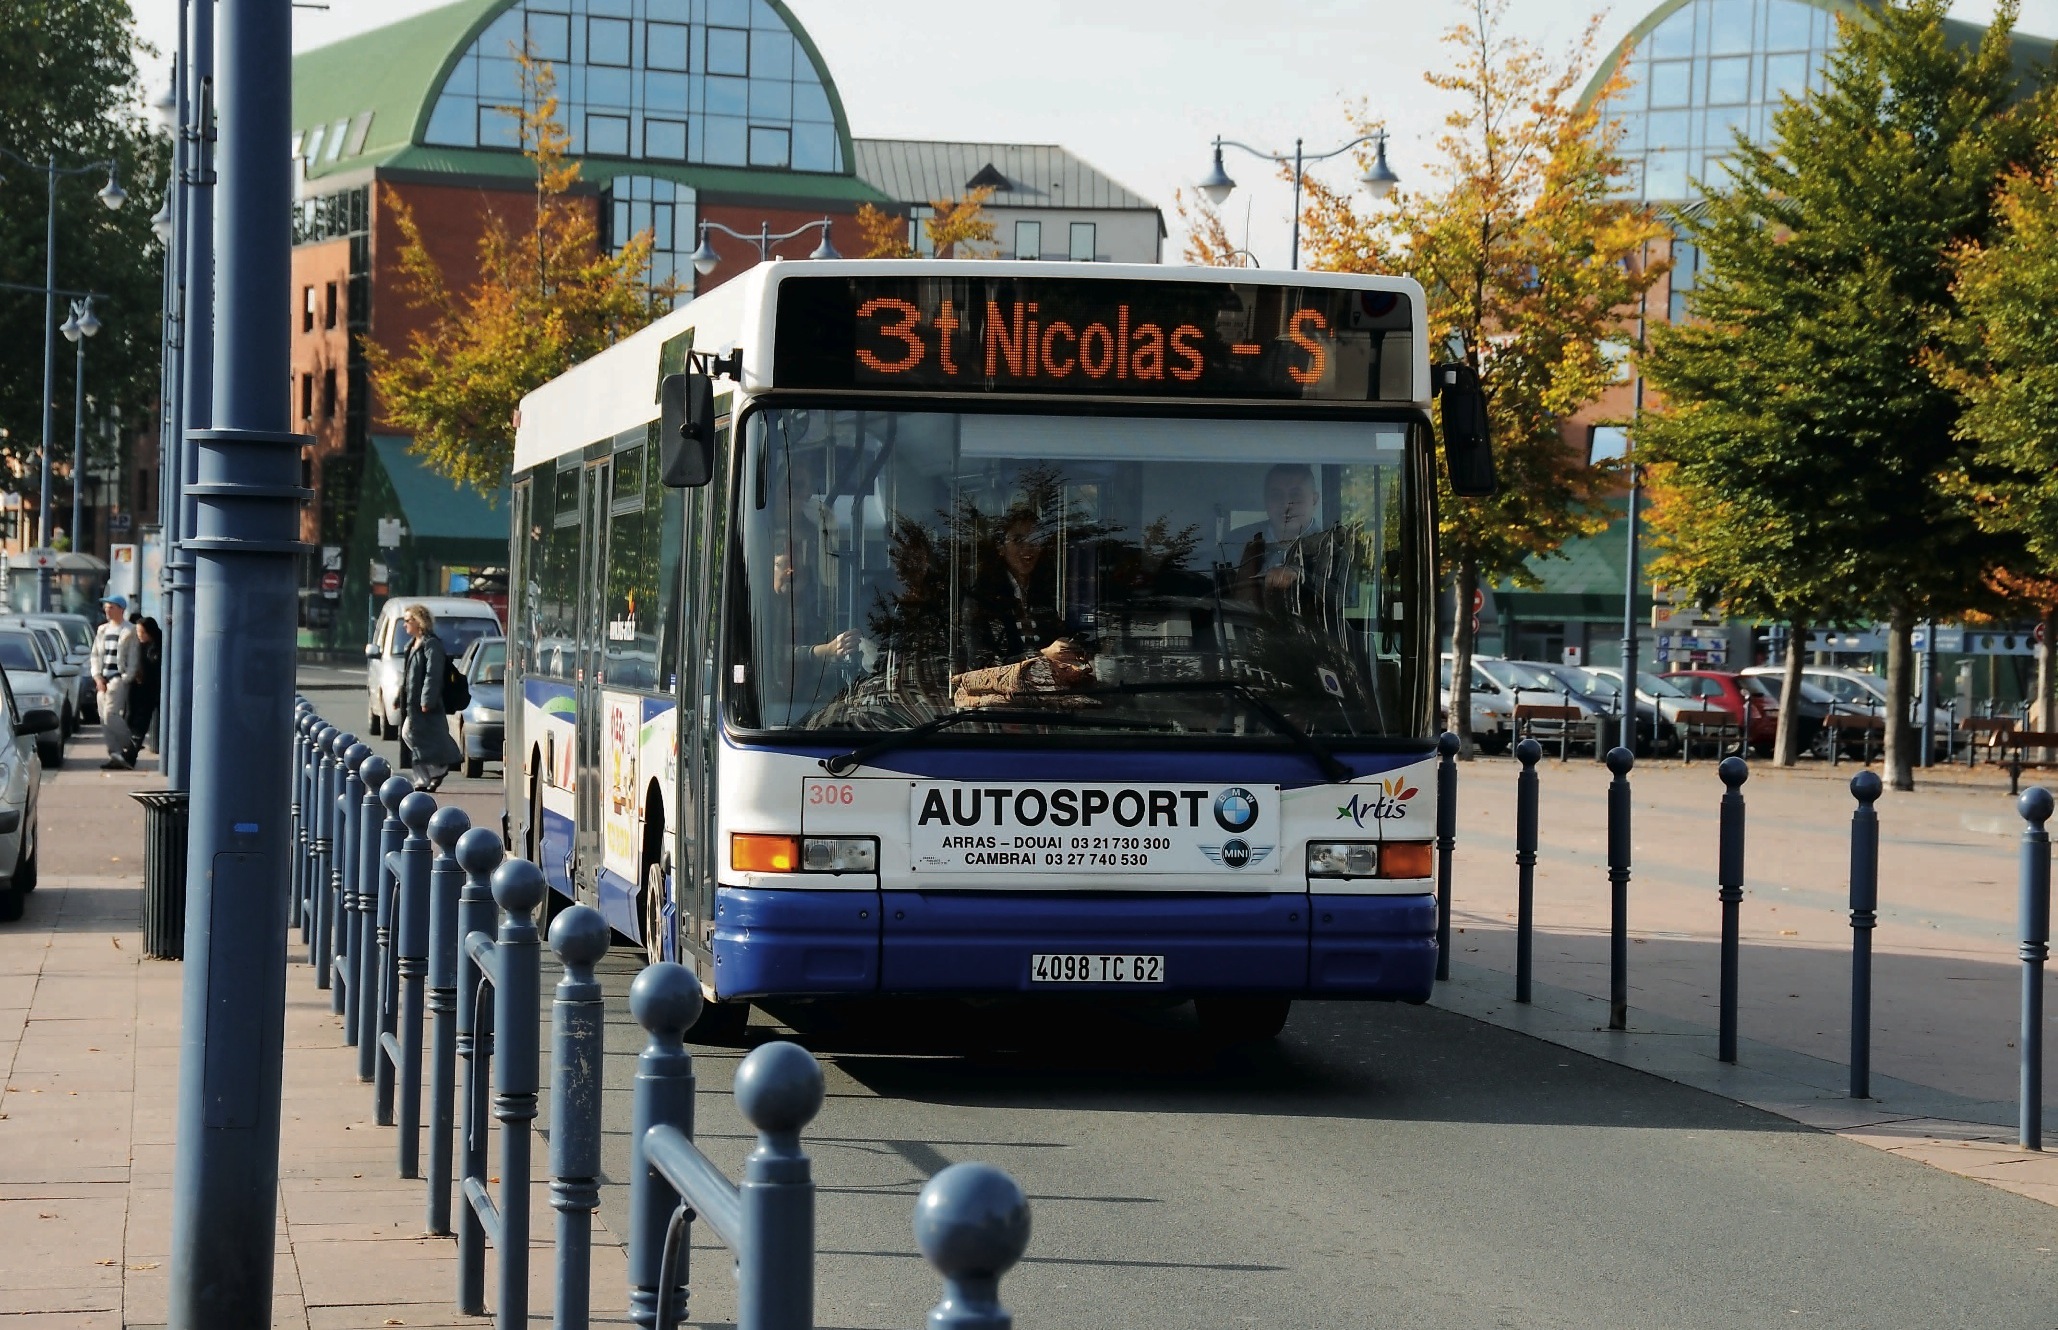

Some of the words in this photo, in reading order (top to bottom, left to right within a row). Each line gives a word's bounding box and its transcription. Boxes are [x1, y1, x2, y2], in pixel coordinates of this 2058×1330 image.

[985, 301, 1205, 380] Nicolas
[1911, 631, 1925, 646] P
[809, 784, 854, 805] 306
[918, 788, 1209, 828] AUTOSPORT
[1336, 793, 1407, 829] Artis
[942, 836, 996, 849] ARRAS
[1014, 836, 1062, 849] DOUAI
[1071, 837, 1089, 849] 03
[1143, 838, 1171, 850] 300
[964, 852, 1036, 865] CAMBRAI
[1045, 853, 1063, 865] 03
[1067, 853, 1085, 865] 27
[1089, 853, 1116, 865] 740
[1120, 854, 1148, 866] 530
[1224, 849, 1249, 859] MINI
[1036, 955, 1090, 981] 4098
[1099, 956, 1124, 981] TC
[1133, 956, 1159, 981] 62
